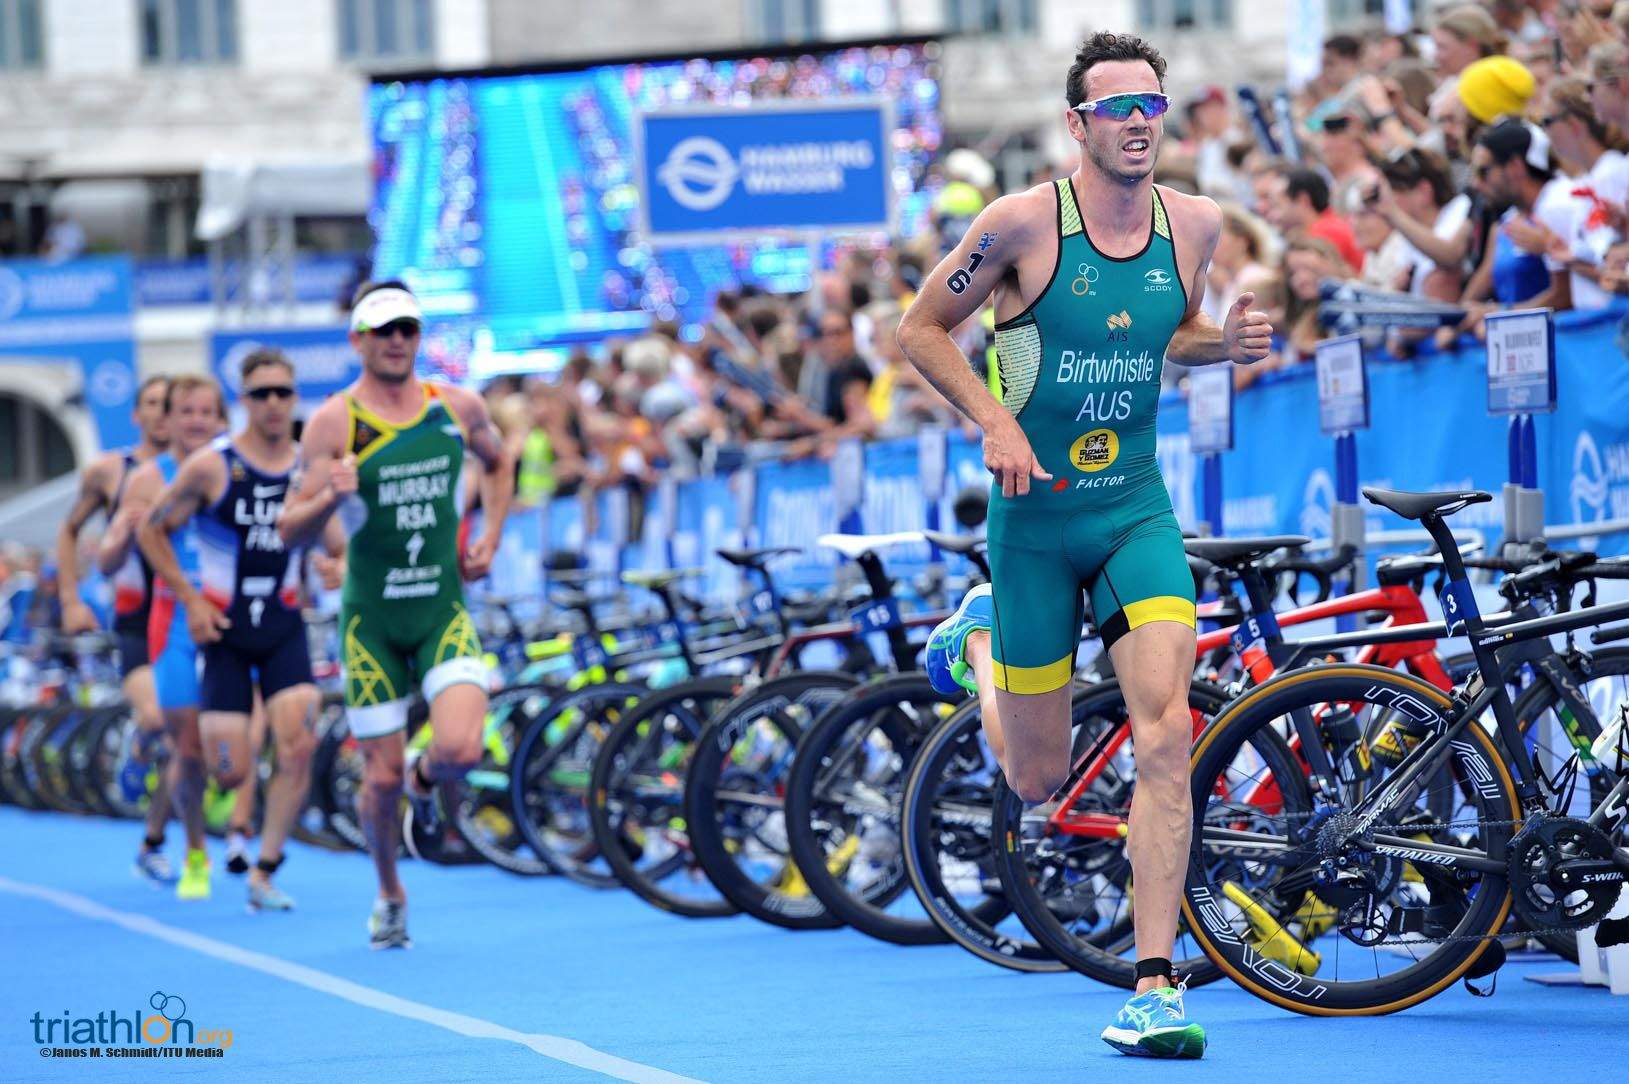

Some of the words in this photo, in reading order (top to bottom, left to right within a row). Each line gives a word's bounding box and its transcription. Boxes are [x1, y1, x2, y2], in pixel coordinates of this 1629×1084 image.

[1107, 331, 1129, 342] AIS
[1056, 350, 1154, 384] Birtwhistle
[1075, 390, 1133, 422] AUS
[378, 473, 450, 506] MURRAY
[1075, 475, 1125, 489] FACTOR
[396, 503, 438, 530] RSA
[1446, 593, 1457, 614] 3
[1248, 618, 1261, 638] 5
[1356, 788, 1400, 834] TARMAC
[1375, 845, 1457, 866] SPECIALIZED
